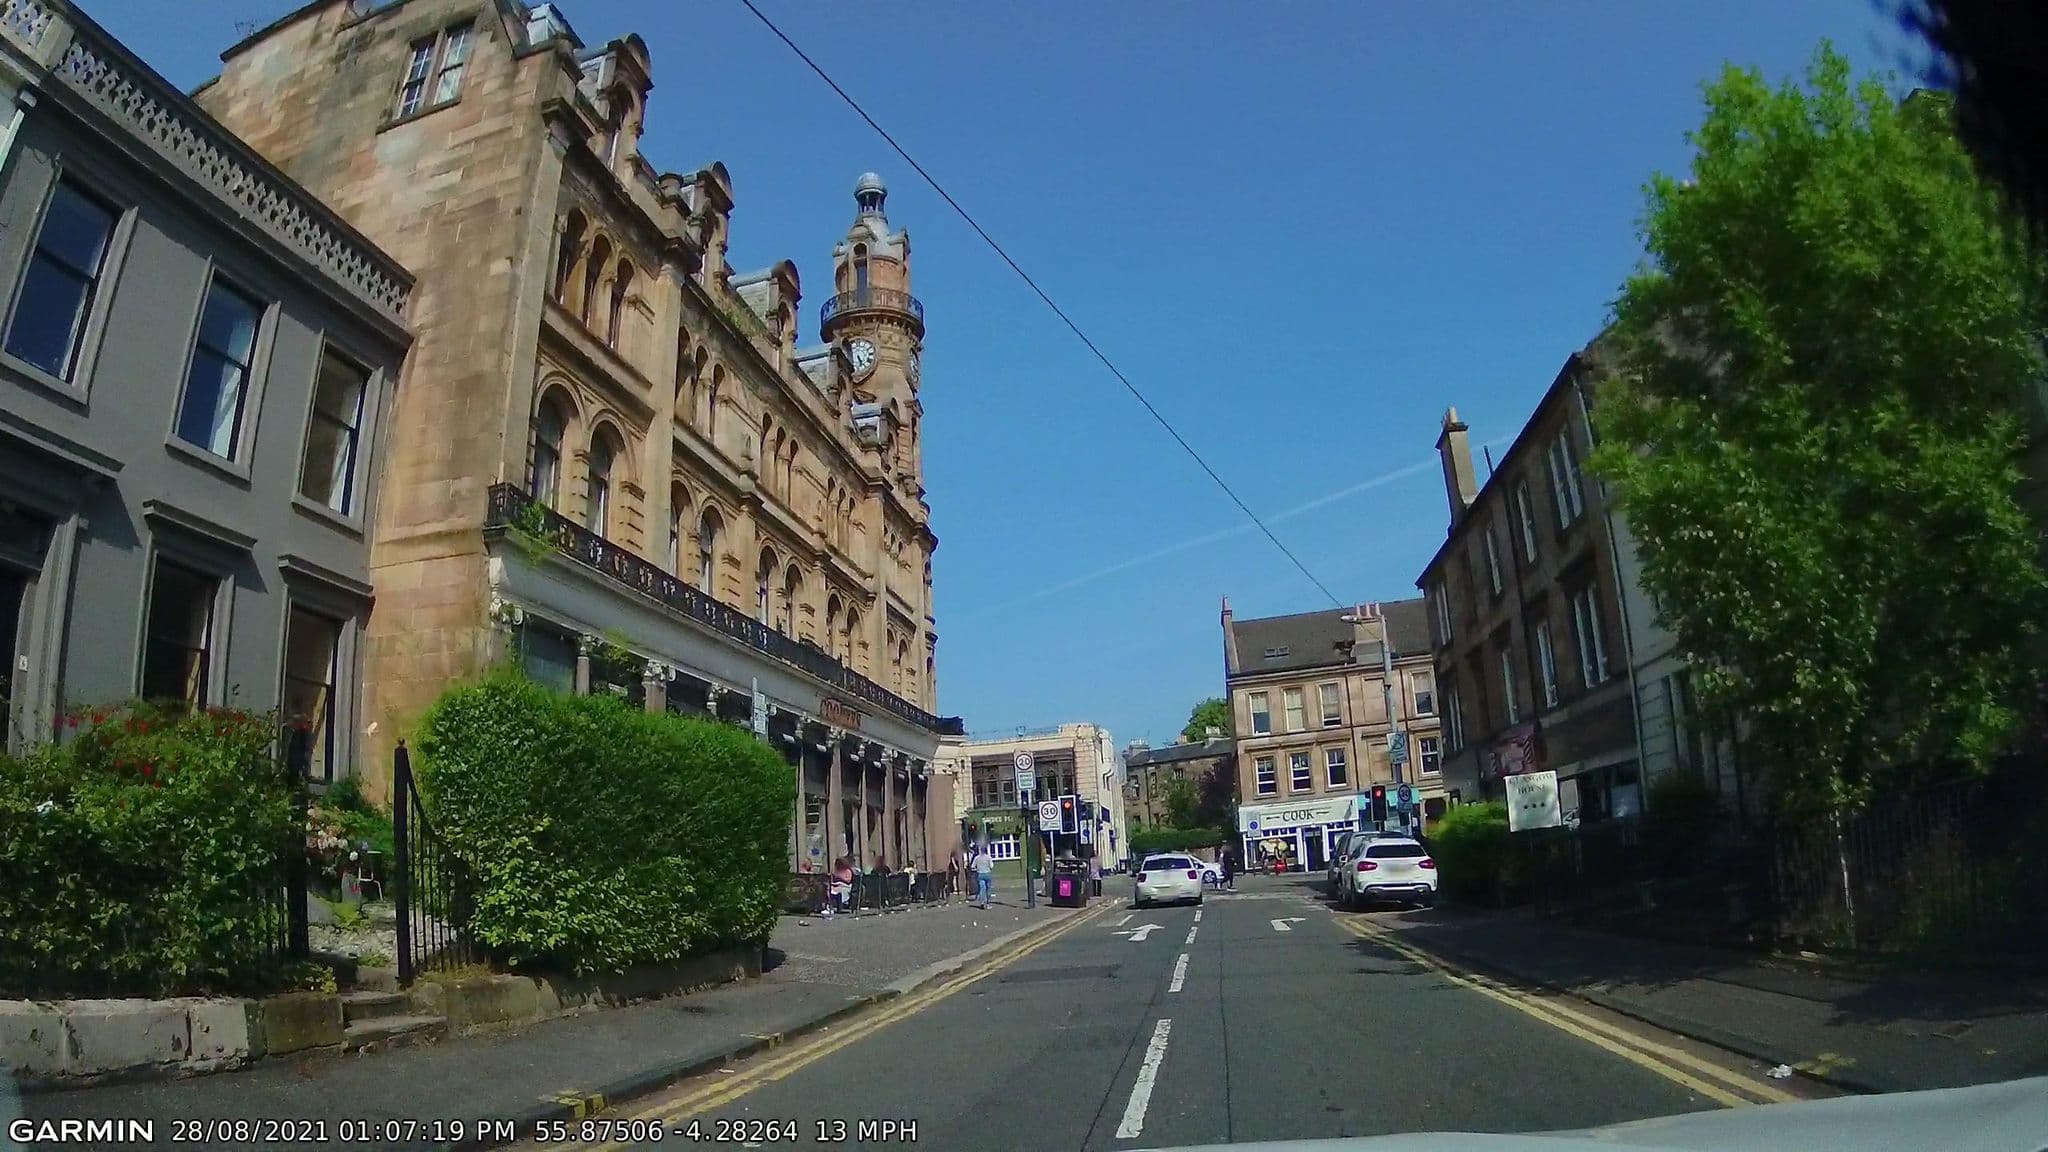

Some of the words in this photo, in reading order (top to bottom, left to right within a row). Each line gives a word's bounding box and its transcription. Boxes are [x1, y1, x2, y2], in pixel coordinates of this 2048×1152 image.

[1018, 757, 1031, 766] 20
[1043, 807, 1056, 816] 30
[1282, 809, 1314, 822] COOK
